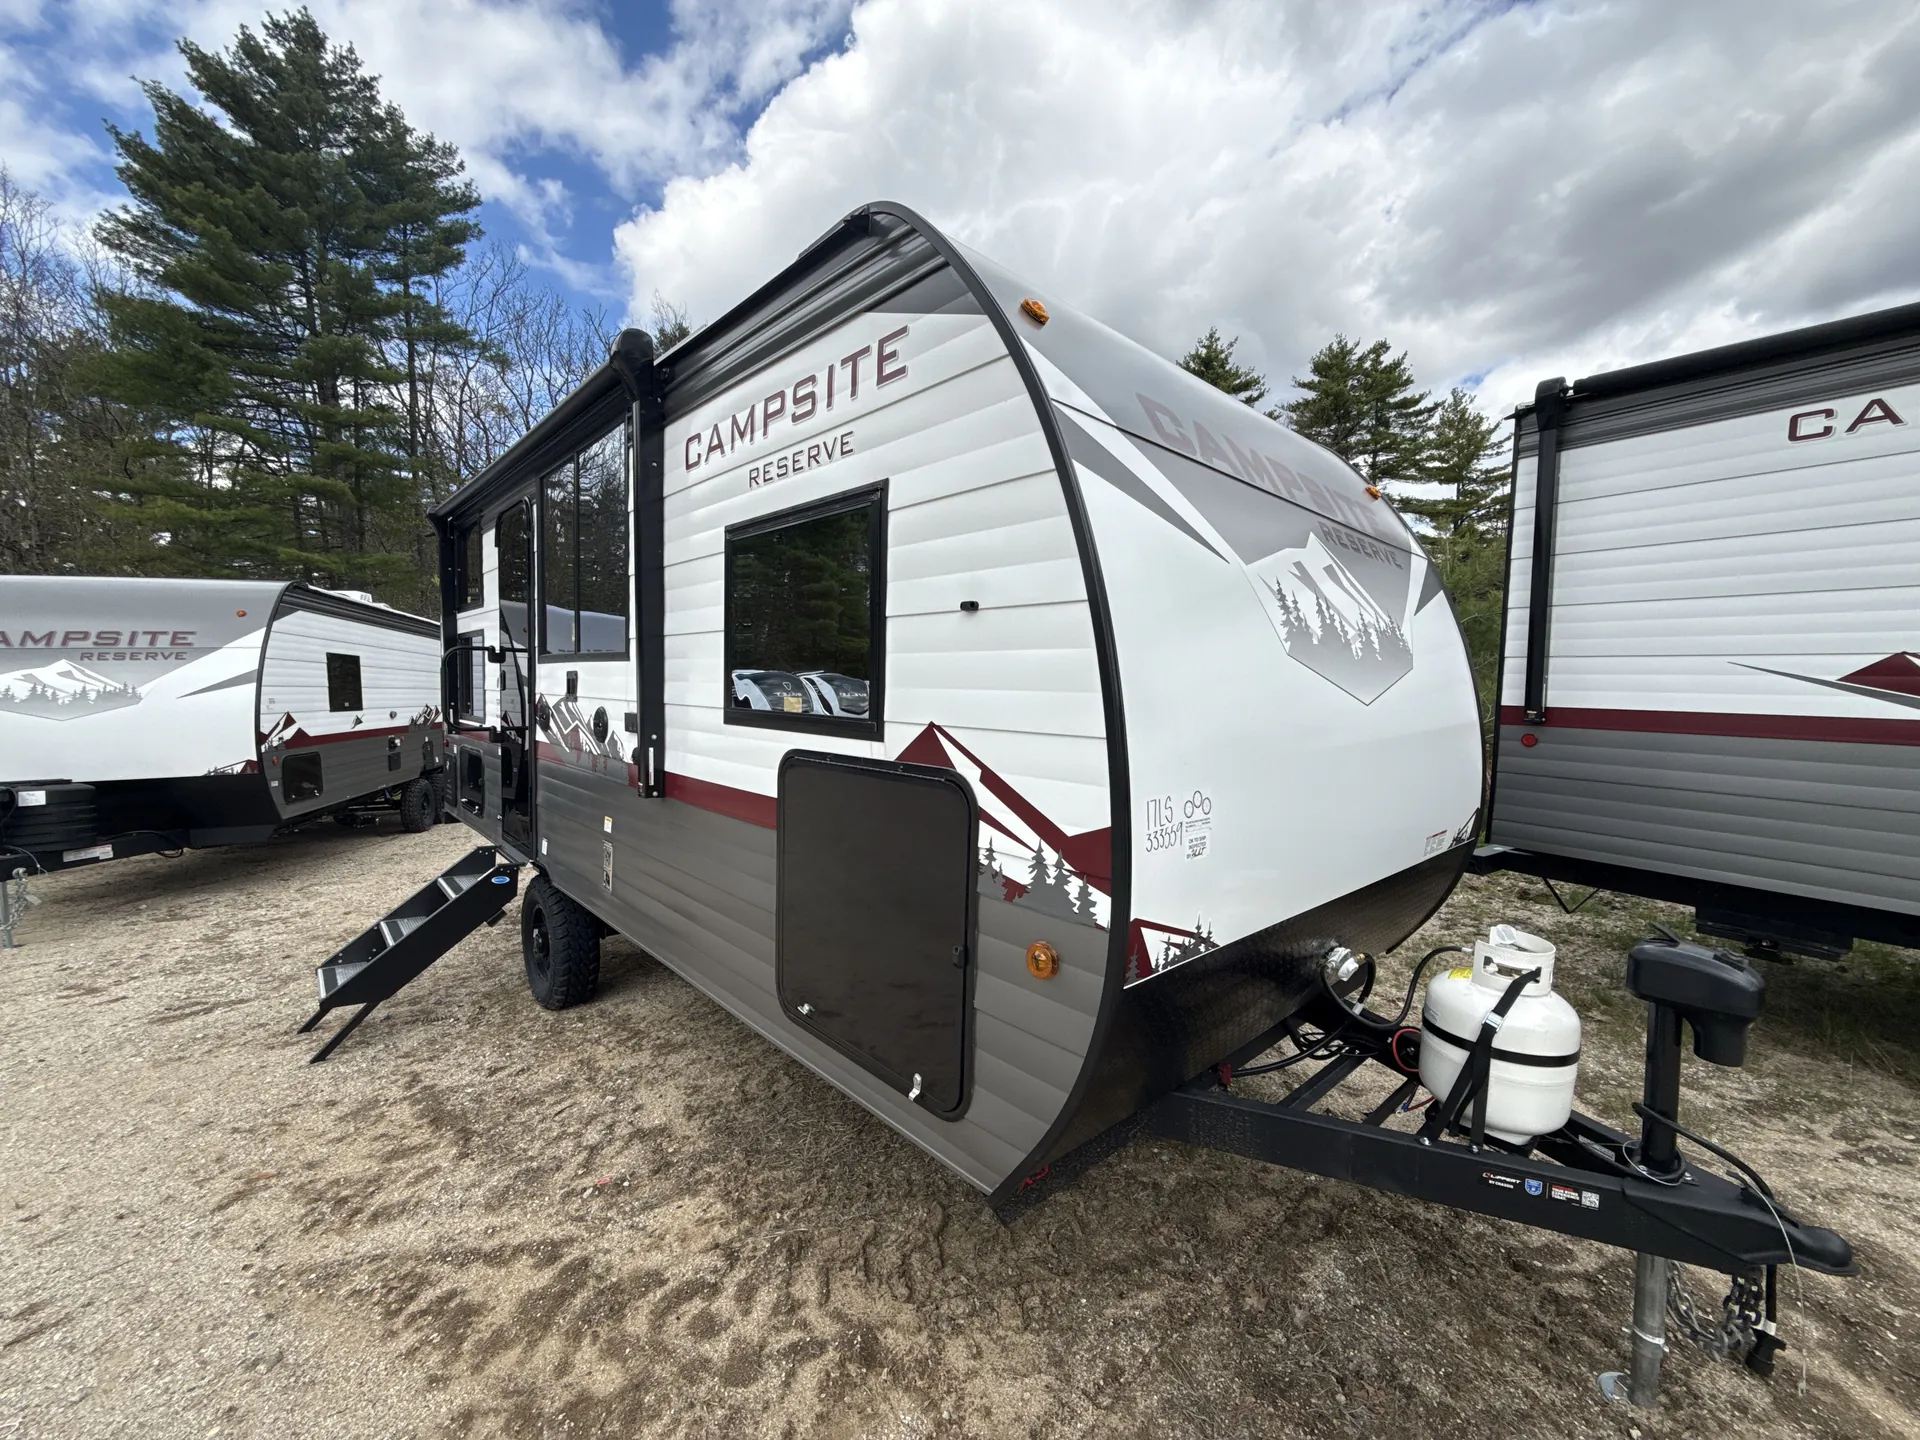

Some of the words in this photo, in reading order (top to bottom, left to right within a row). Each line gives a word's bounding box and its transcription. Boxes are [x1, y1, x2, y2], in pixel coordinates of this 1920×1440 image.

[684, 323, 910, 473] CAMPSITE
[1787, 397, 1906, 443] CA
[748, 430, 855, 489] RESERVE
[1134, 391, 1382, 536] CAMPSITE
[1317, 520, 1404, 571] RESERVE
[79, 651, 188, 662] RESERVE
